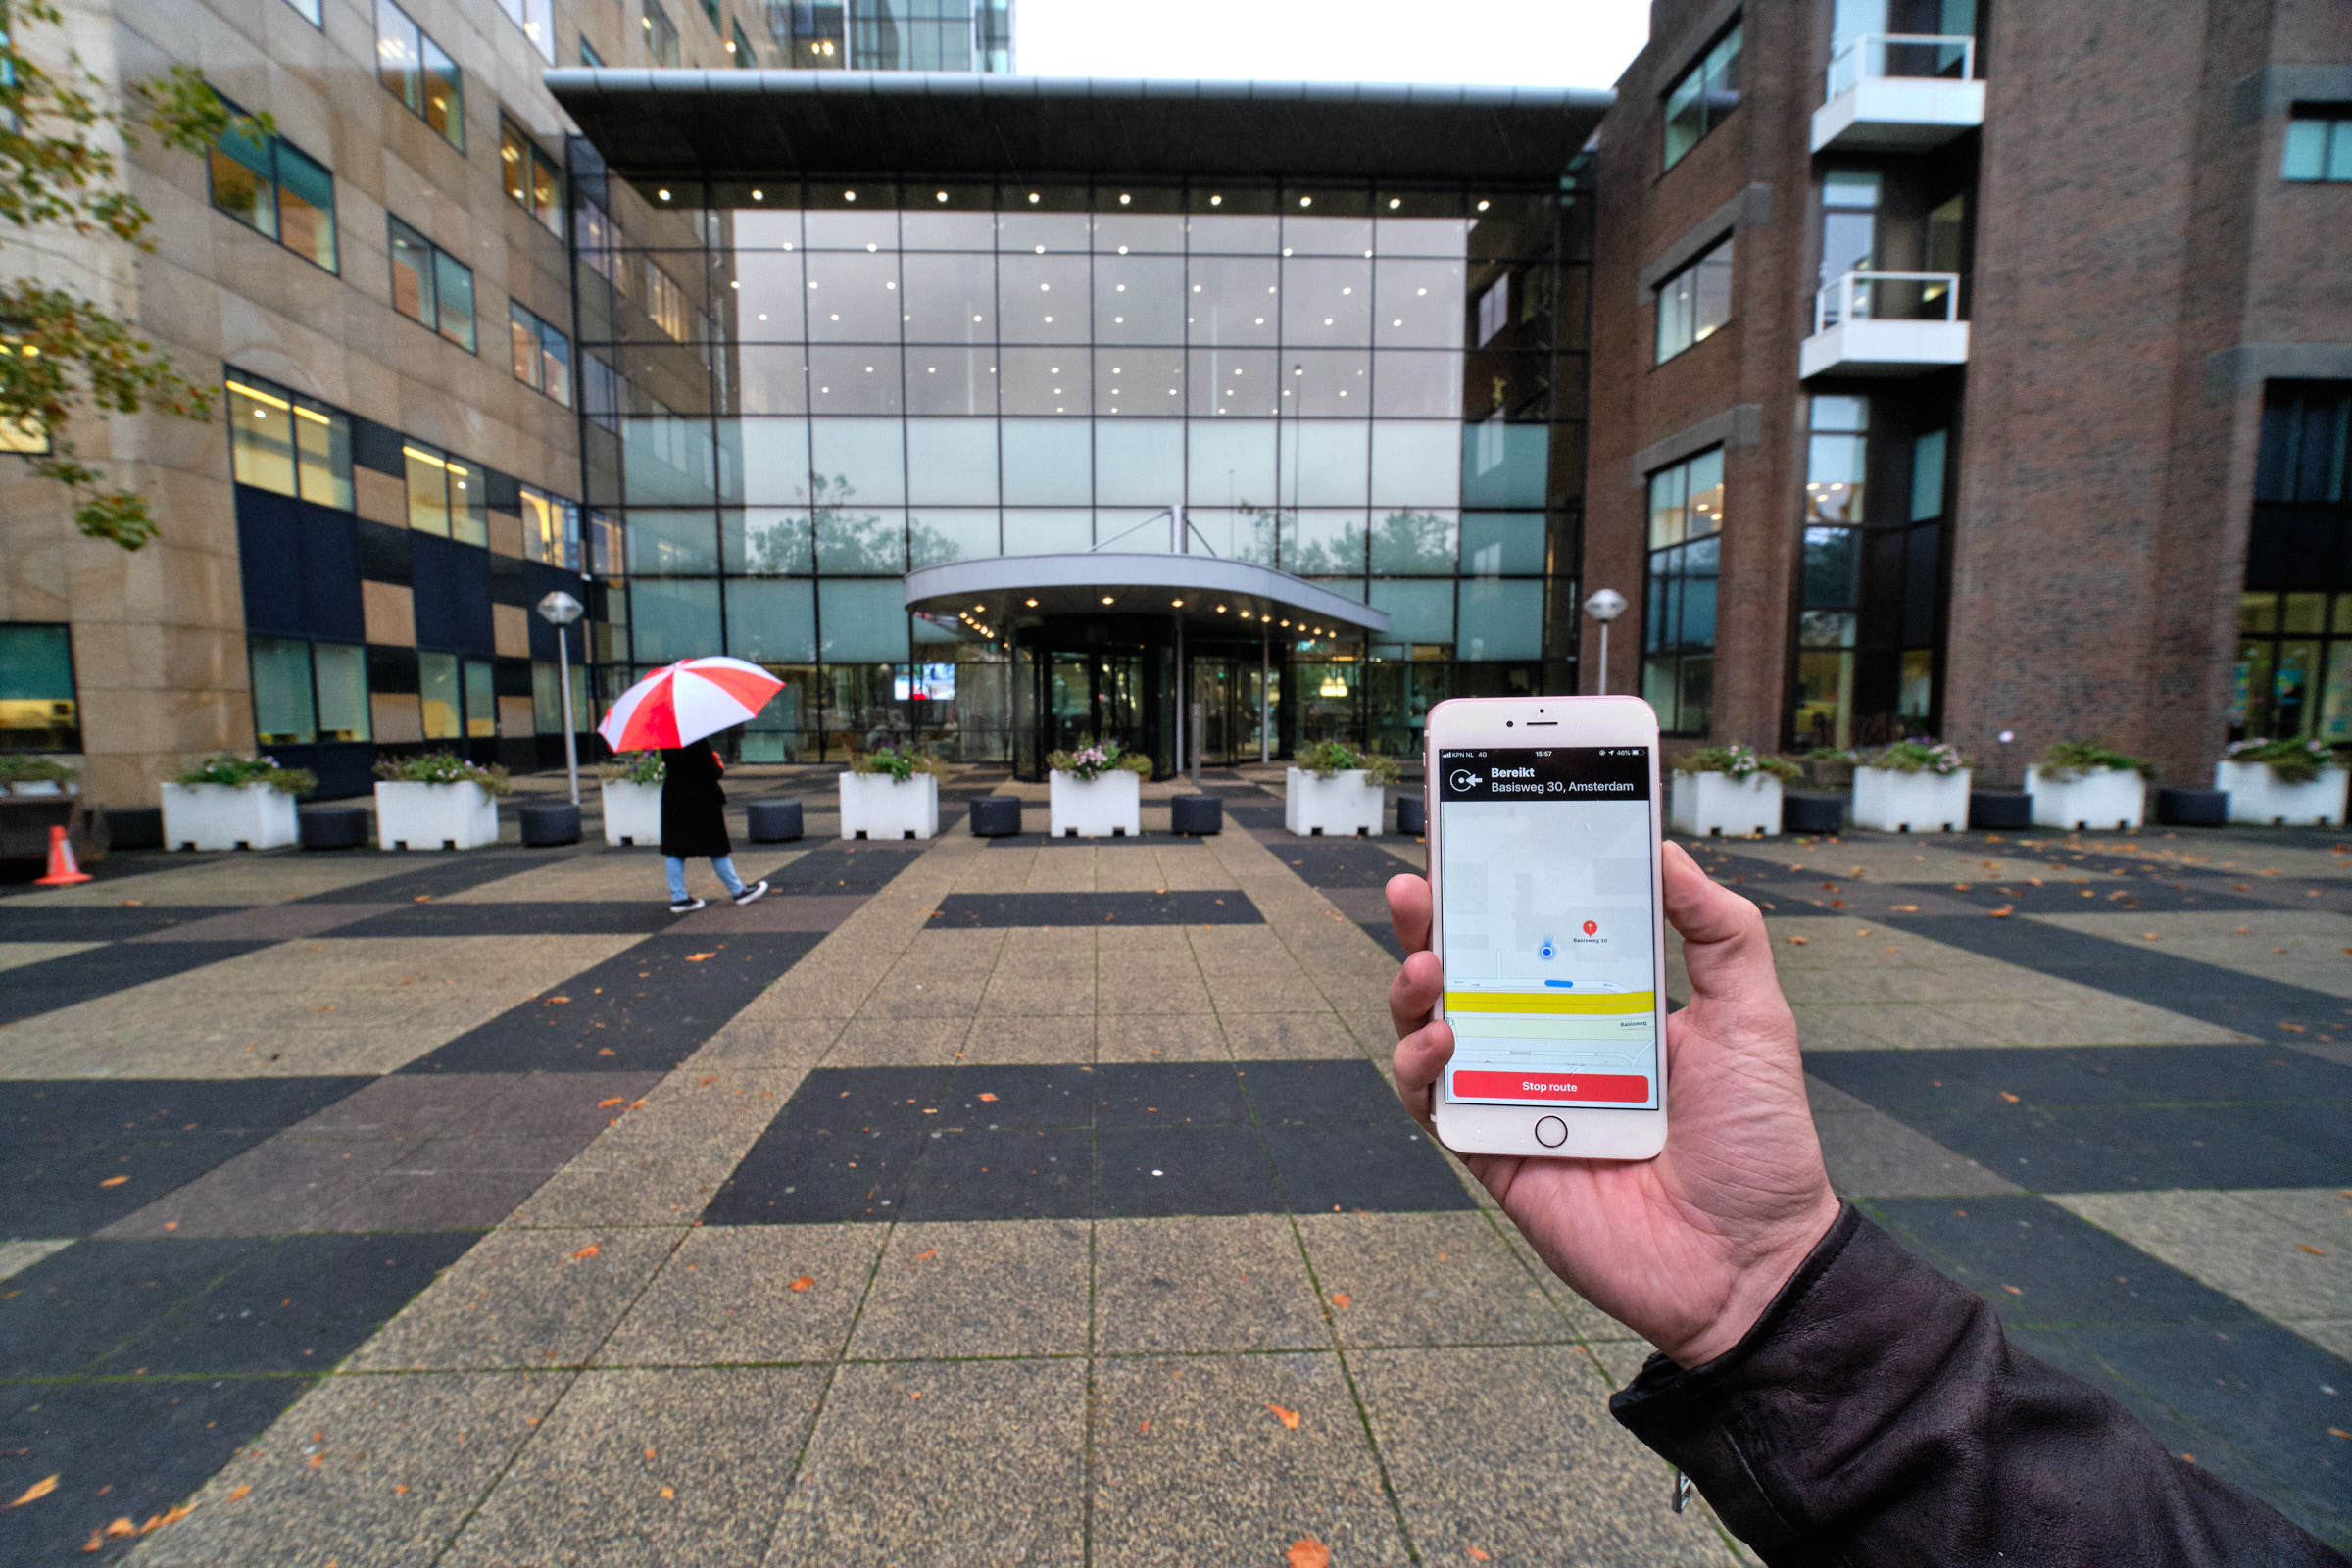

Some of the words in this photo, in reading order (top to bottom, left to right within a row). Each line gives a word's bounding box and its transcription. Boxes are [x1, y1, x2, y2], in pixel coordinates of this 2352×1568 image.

[1491, 767, 1536, 778] Bereikt
[1491, 782, 1544, 794] Basisweg
[1546, 781, 1566, 793] 30,
[1568, 781, 1634, 792] Amsterdam
[1522, 1081, 1547, 1093] Stop
[1548, 1082, 1578, 1093] route
